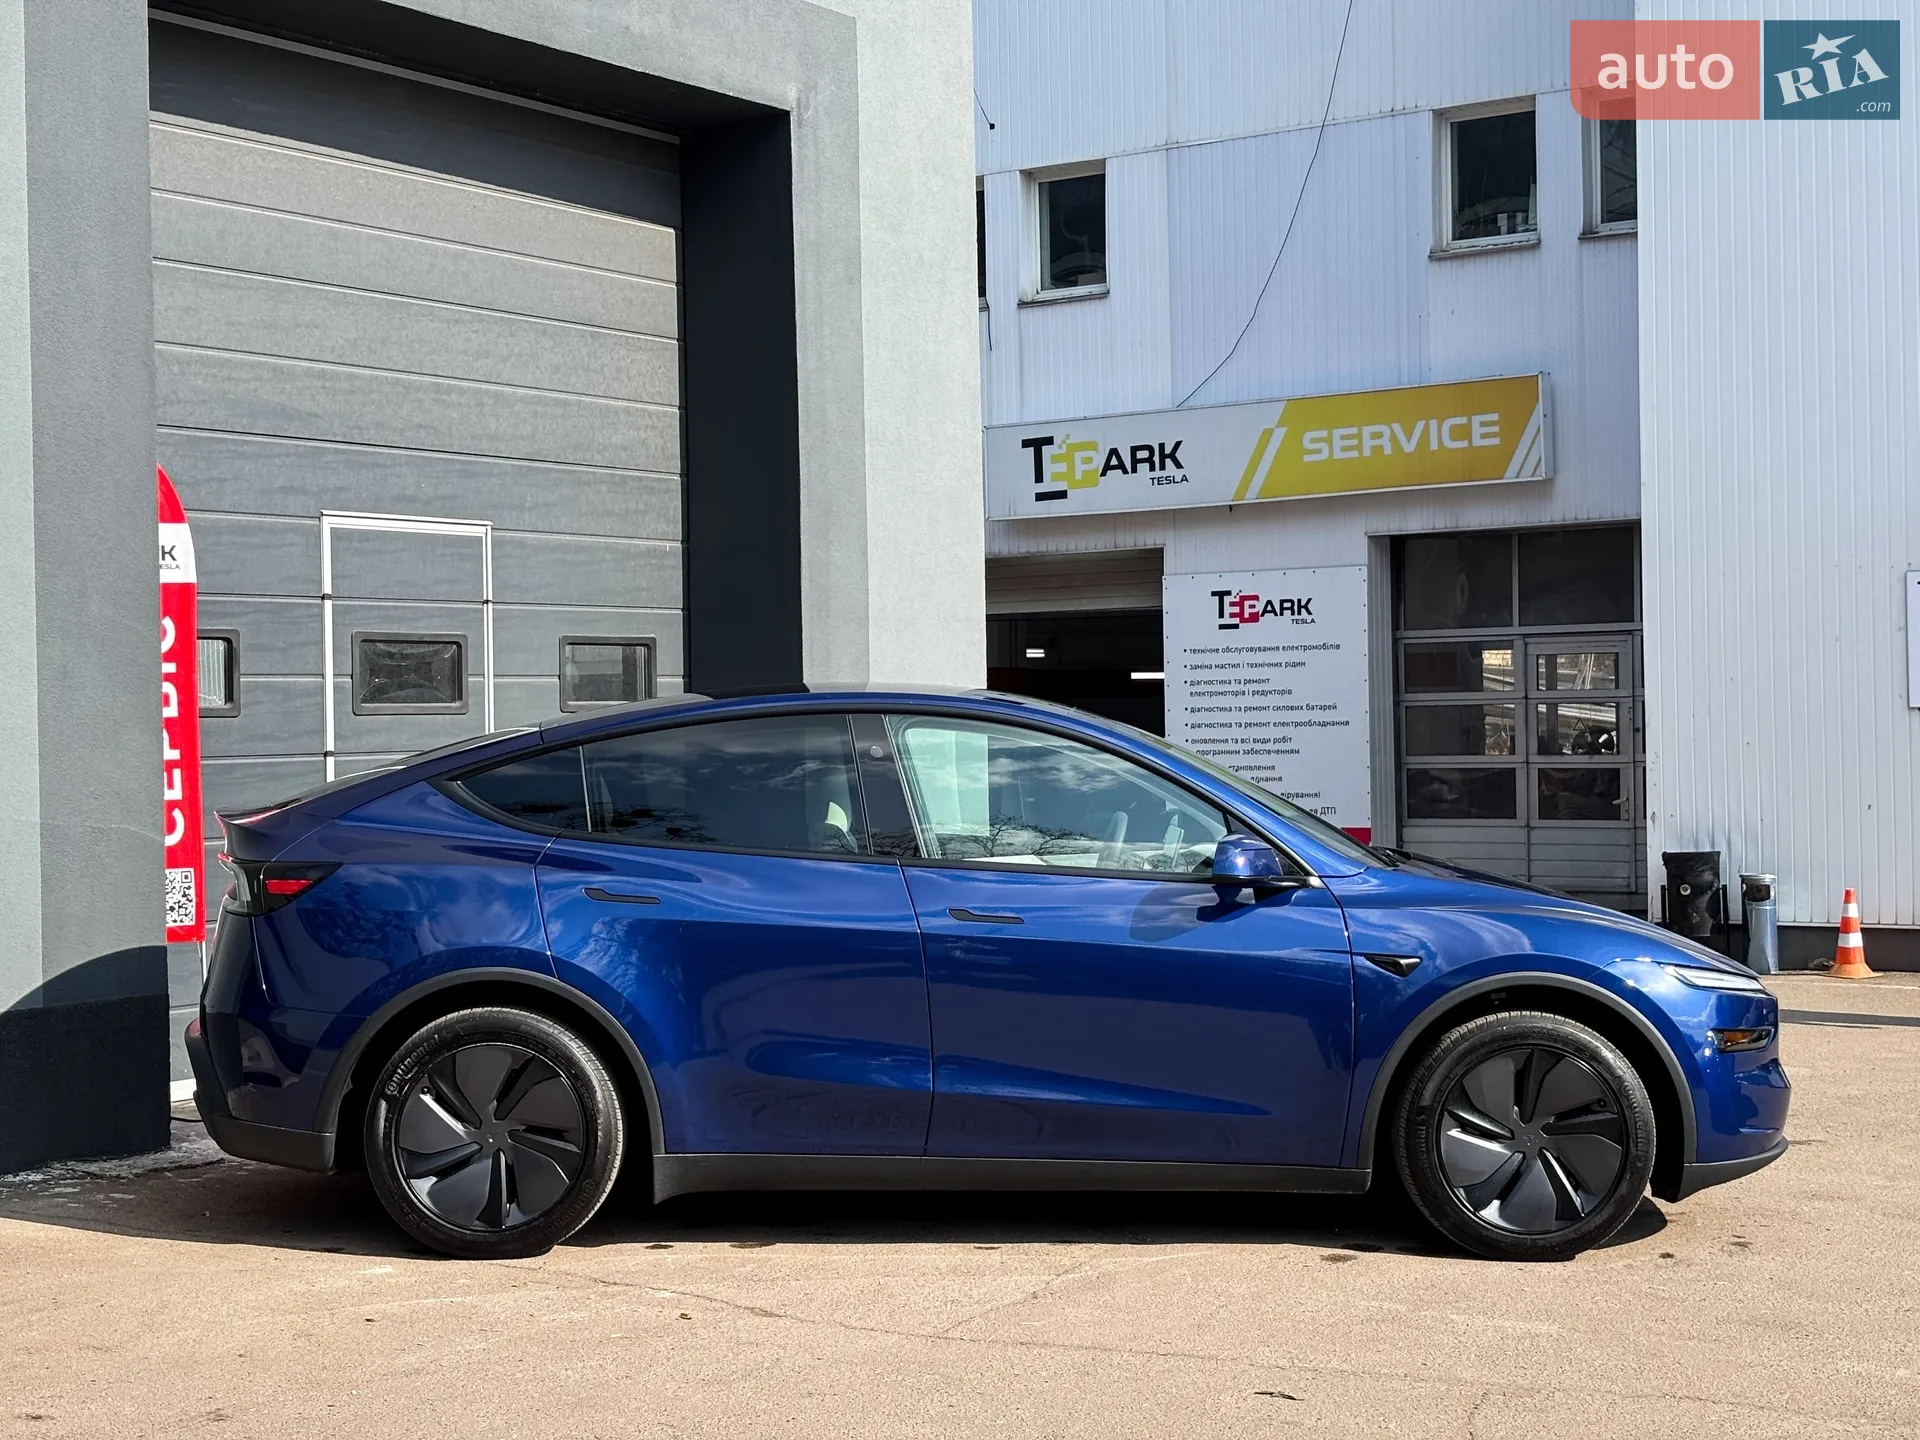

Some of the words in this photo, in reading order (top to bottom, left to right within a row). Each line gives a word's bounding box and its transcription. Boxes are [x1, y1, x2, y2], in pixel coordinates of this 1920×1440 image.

[1302, 412, 1501, 462] SERVICE
[1149, 473, 1189, 487] TESLA
[1189, 646, 1220, 655] технічне
[1222, 645, 1280, 655] обслуговування
[1282, 643, 1341, 653] електромобілів
[1189, 662, 1213, 671] заміна
[1214, 662, 1241, 670] мастил
[1246, 660, 1283, 669] технічних
[1284, 660, 1306, 670] рідин
[1189, 678, 1232, 687] діагностика
[1243, 678, 1271, 686] ремонт
[1189, 689, 1246, 698] електромоторів
[1251, 688, 1293, 698] редукторів
[1189, 705, 1233, 714] діагностика
[1234, 704, 1242, 712] та
[1243, 704, 1271, 713] ремонт
[1306, 703, 1338, 712] батарей
[1190, 721, 1233, 729] діагностика
[1244, 721, 1271, 729] ремонт
[1272, 719, 1350, 729] електрообладнання
[1190, 737, 1229, 745] оновлення
[1240, 736, 1251, 744] всі
[1252, 737, 1272, 745] види
[1273, 735, 1292, 745] робіт
[1242, 747, 1300, 756] забеспеченням
[1319, 806, 1337, 816] ДТП
